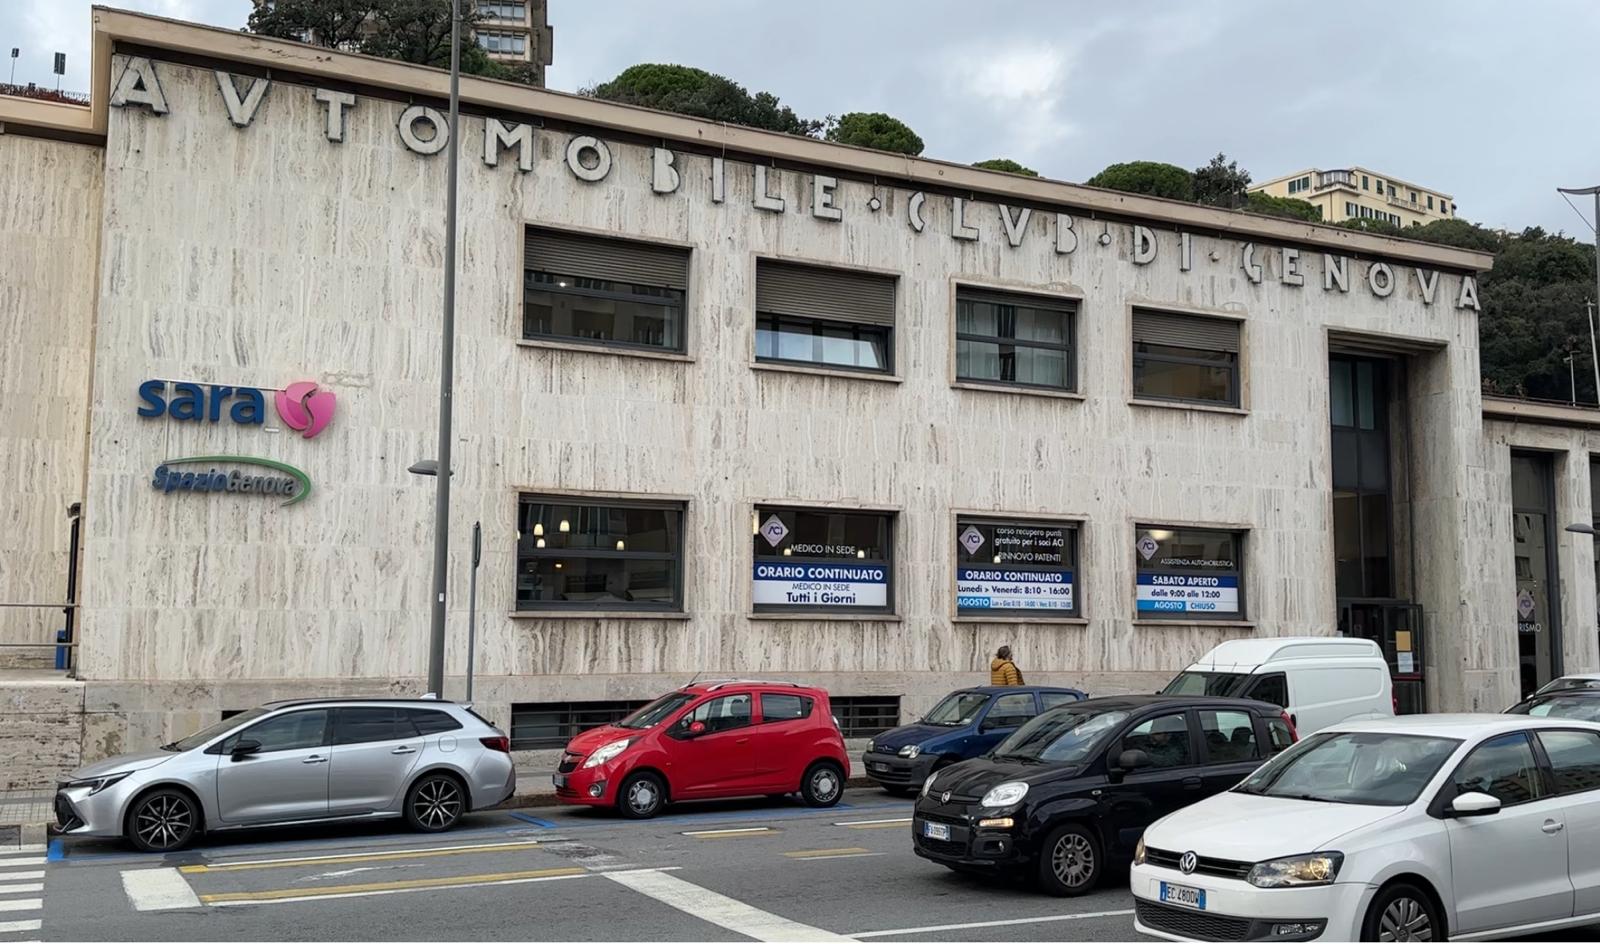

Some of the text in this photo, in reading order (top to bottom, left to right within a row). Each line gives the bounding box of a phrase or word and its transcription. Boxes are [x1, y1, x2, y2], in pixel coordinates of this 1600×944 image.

[110, 55, 843, 222] AVTOMOBILE
[1132, 225, 1192, 271] DI
[1242, 242, 1481, 311] GENOVA
[137, 379, 265, 425] sara
[152, 464, 298, 496] SpazioGenova
[1016, 529, 1045, 538] recupero
[995, 537, 1021, 546] gratuito
[1022, 539, 1033, 547] per
[1038, 538, 1051, 547] soci
[1052, 539, 1064, 547] ACI
[791, 544, 855, 555] MEDICO IN SEDE
[999, 552, 1061, 562] RINNOVO PATENTI
[757, 566, 884, 581] ORARIO CONTINUATO
[965, 571, 1063, 582] ORARIO CONTINUATO
[1152, 576, 1219, 586] SABATO APERTO
[791, 583, 822, 591] MEDICO
[823, 583, 832, 591] IN
[1024, 586, 1041, 594] 8:10
[1049, 586, 1070, 595] 16:00
[786, 592, 811, 603] Tutti
[821, 592, 856, 604] Giorni
[1151, 589, 1221, 599] dalle 9:00 alle 12:00
[958, 598, 989, 607] AGOSTO
[1154, 601, 1216, 610] AGOSTO CHIUSO
[1520, 623, 1541, 632] RISMO
